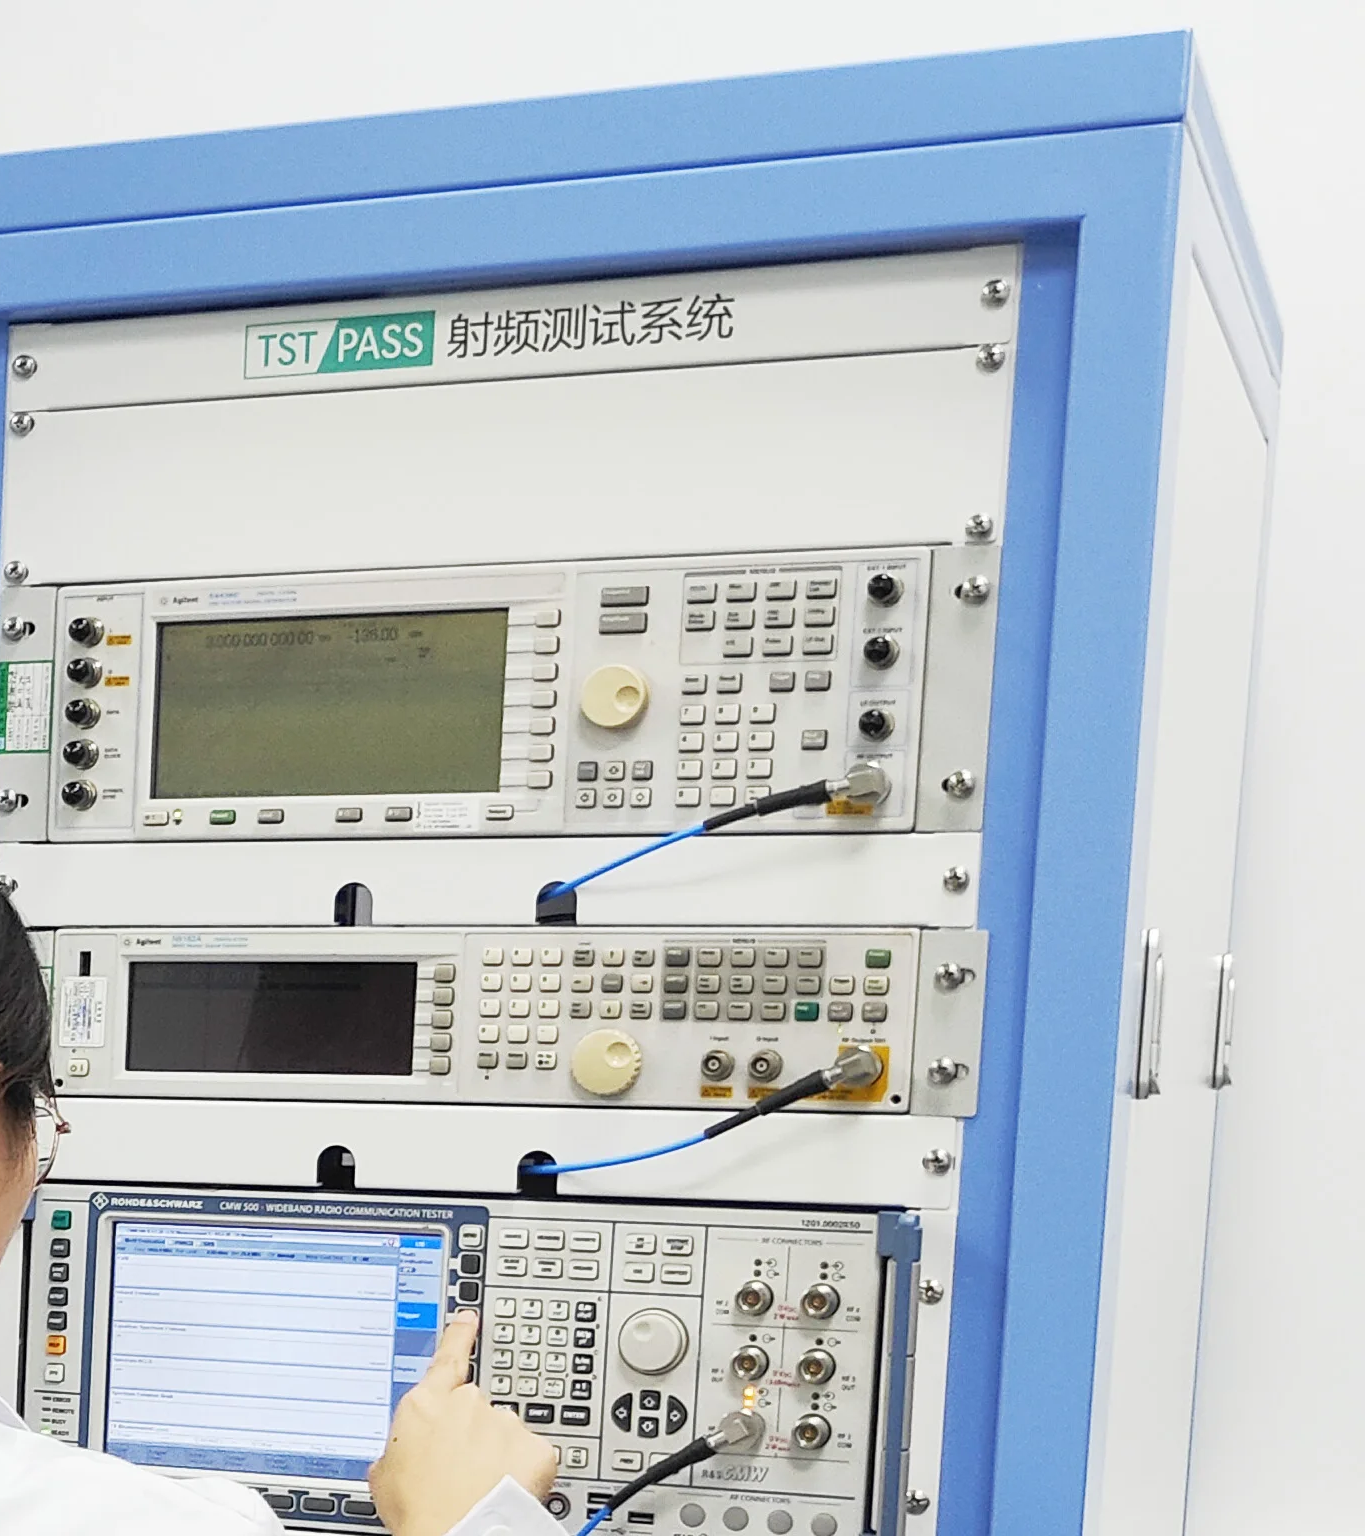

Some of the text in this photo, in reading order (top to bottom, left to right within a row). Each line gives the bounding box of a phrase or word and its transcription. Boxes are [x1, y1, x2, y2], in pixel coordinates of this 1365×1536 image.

[447, 293, 735, 359] 射频测试系统
[337, 322, 424, 363] PASS
[173, 596, 199, 605] Agilent
[136, 938, 162, 948] Agilent
[219, 1201, 453, 1219] CMW 500 WIDEBAND RADIO COMMUNICATION TESTER
[772, 1238, 823, 1246] CONNECTORS
[724, 1466, 769, 1482] CMW
[741, 1495, 790, 1504] CONNECTORS
